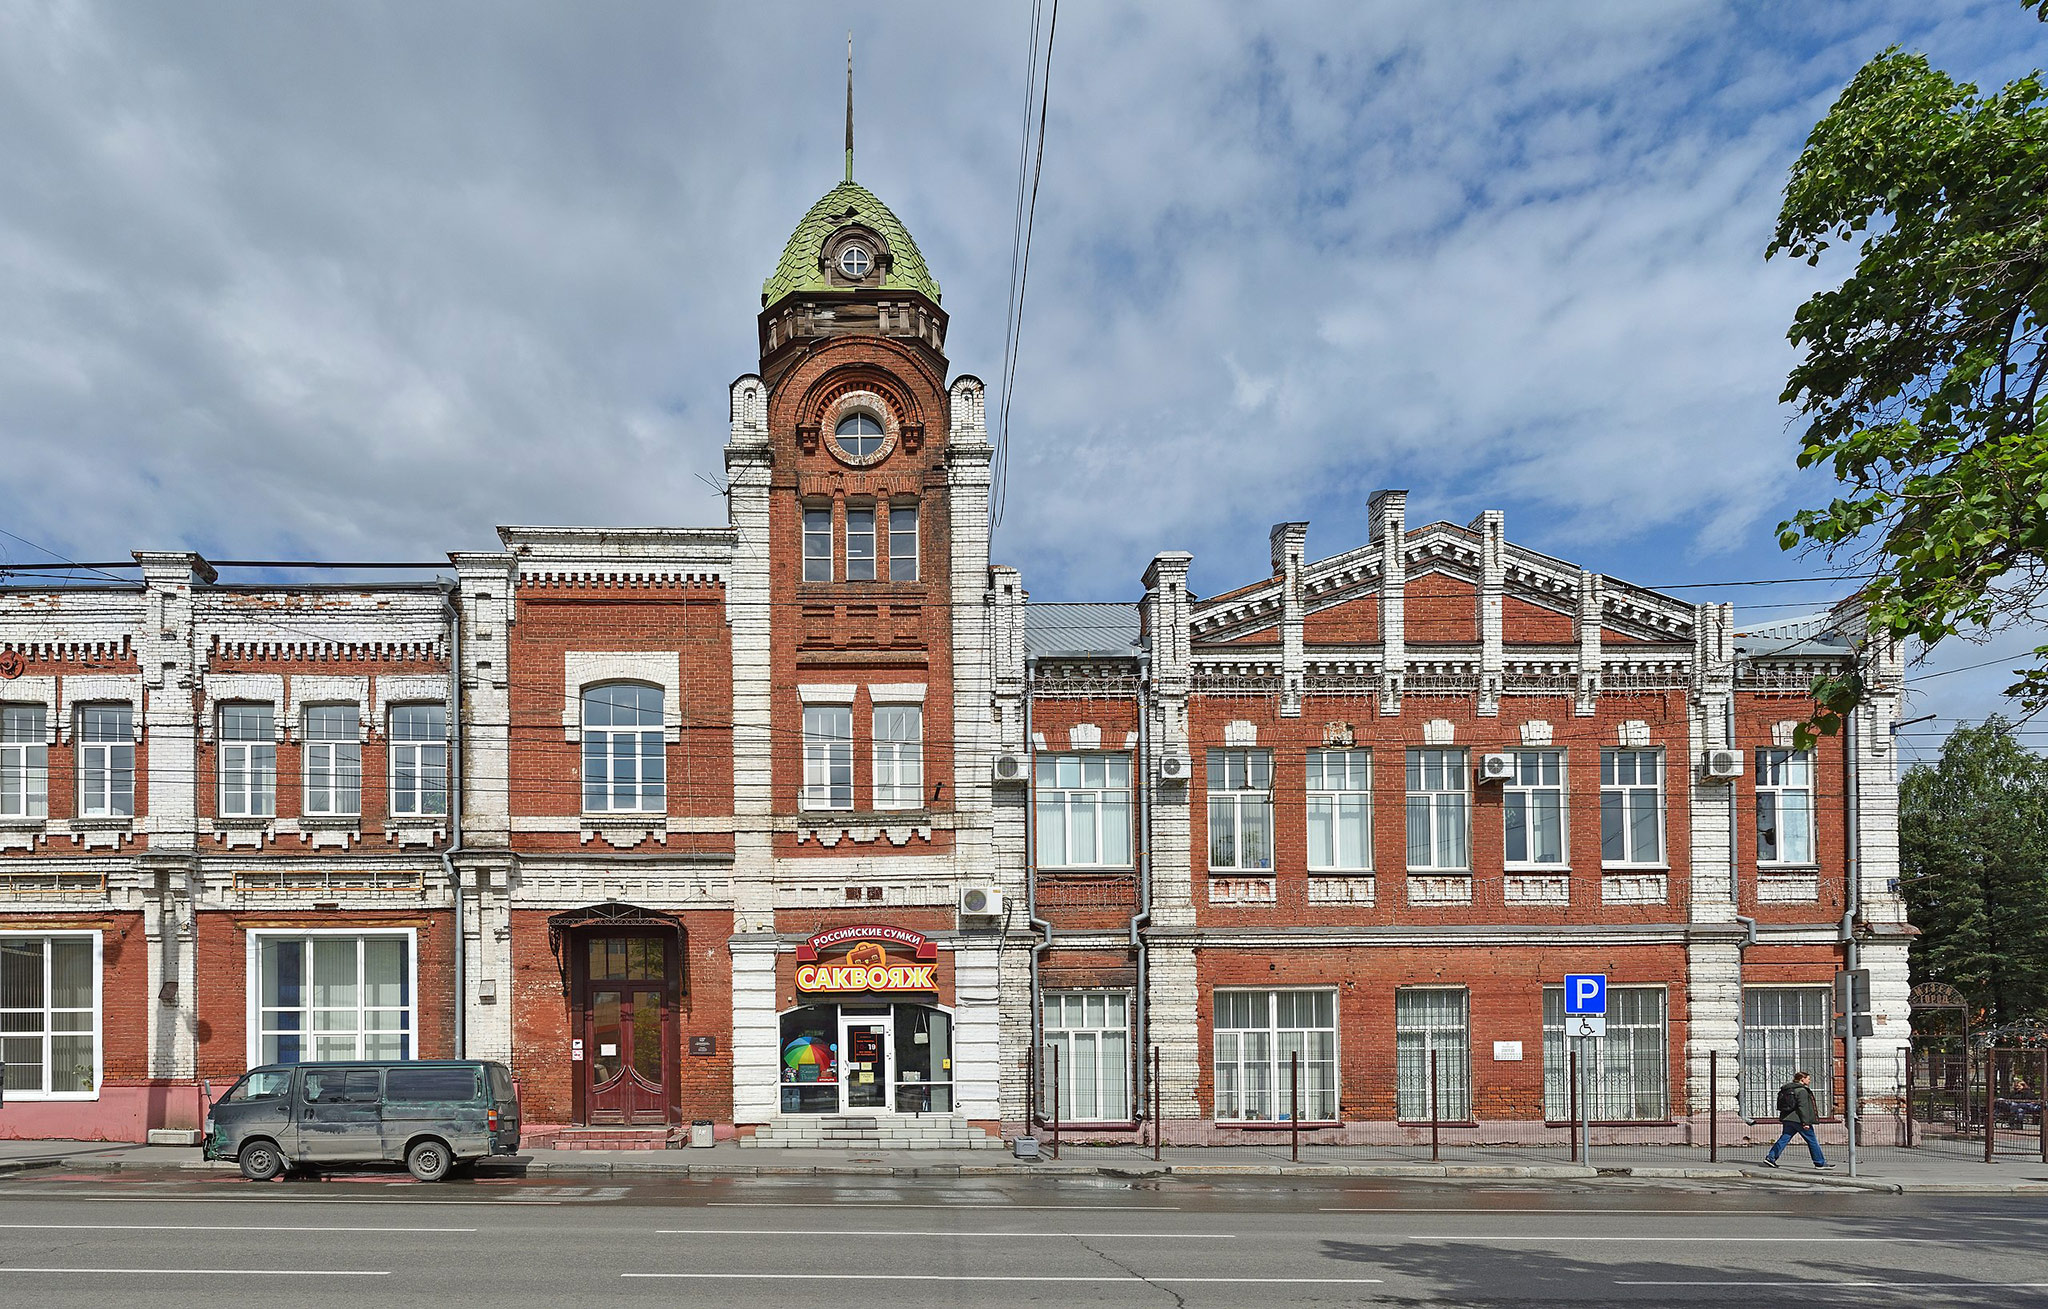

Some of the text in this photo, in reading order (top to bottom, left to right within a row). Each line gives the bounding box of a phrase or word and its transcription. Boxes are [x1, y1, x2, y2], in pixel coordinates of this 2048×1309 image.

[813, 928, 921, 947] РОССИЙСКИЕ СУМКИ
[798, 967, 933, 989] САКВОЯЖ
[1577, 979, 1599, 1009] P
